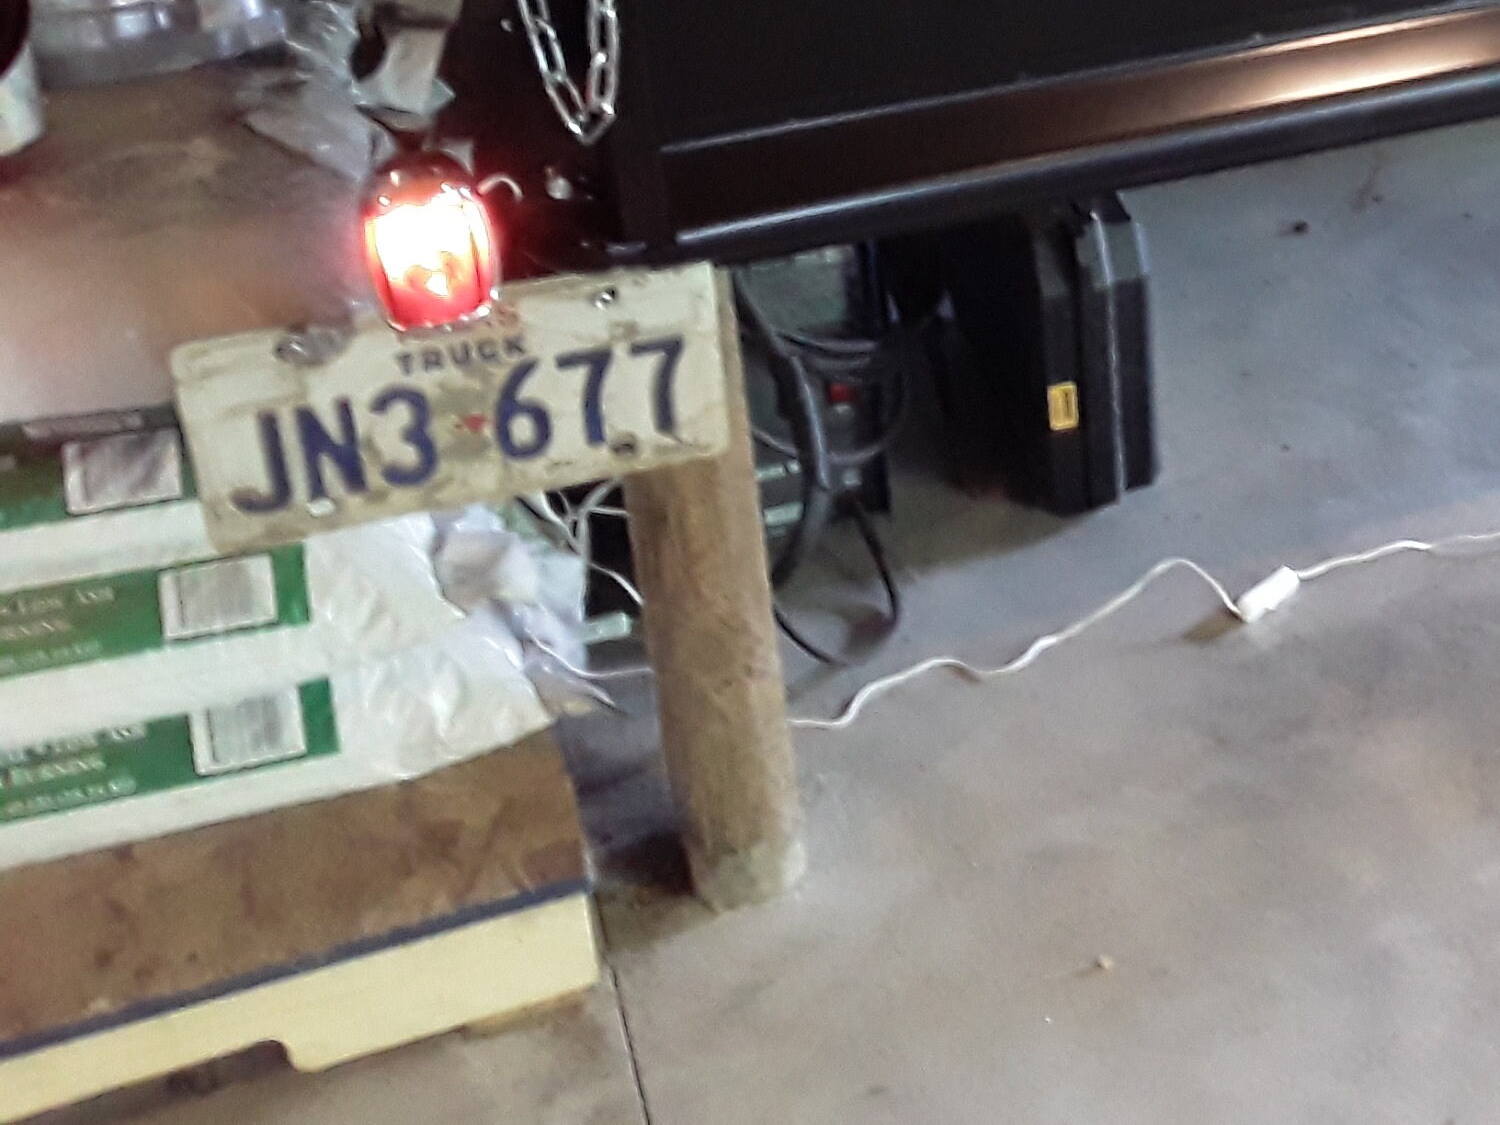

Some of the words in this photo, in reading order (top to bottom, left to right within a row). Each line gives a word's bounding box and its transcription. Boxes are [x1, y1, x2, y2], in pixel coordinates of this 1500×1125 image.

[397, 334, 526, 375] TRUCK
[230, 387, 440, 516] JN3
[493, 335, 687, 461] 677
